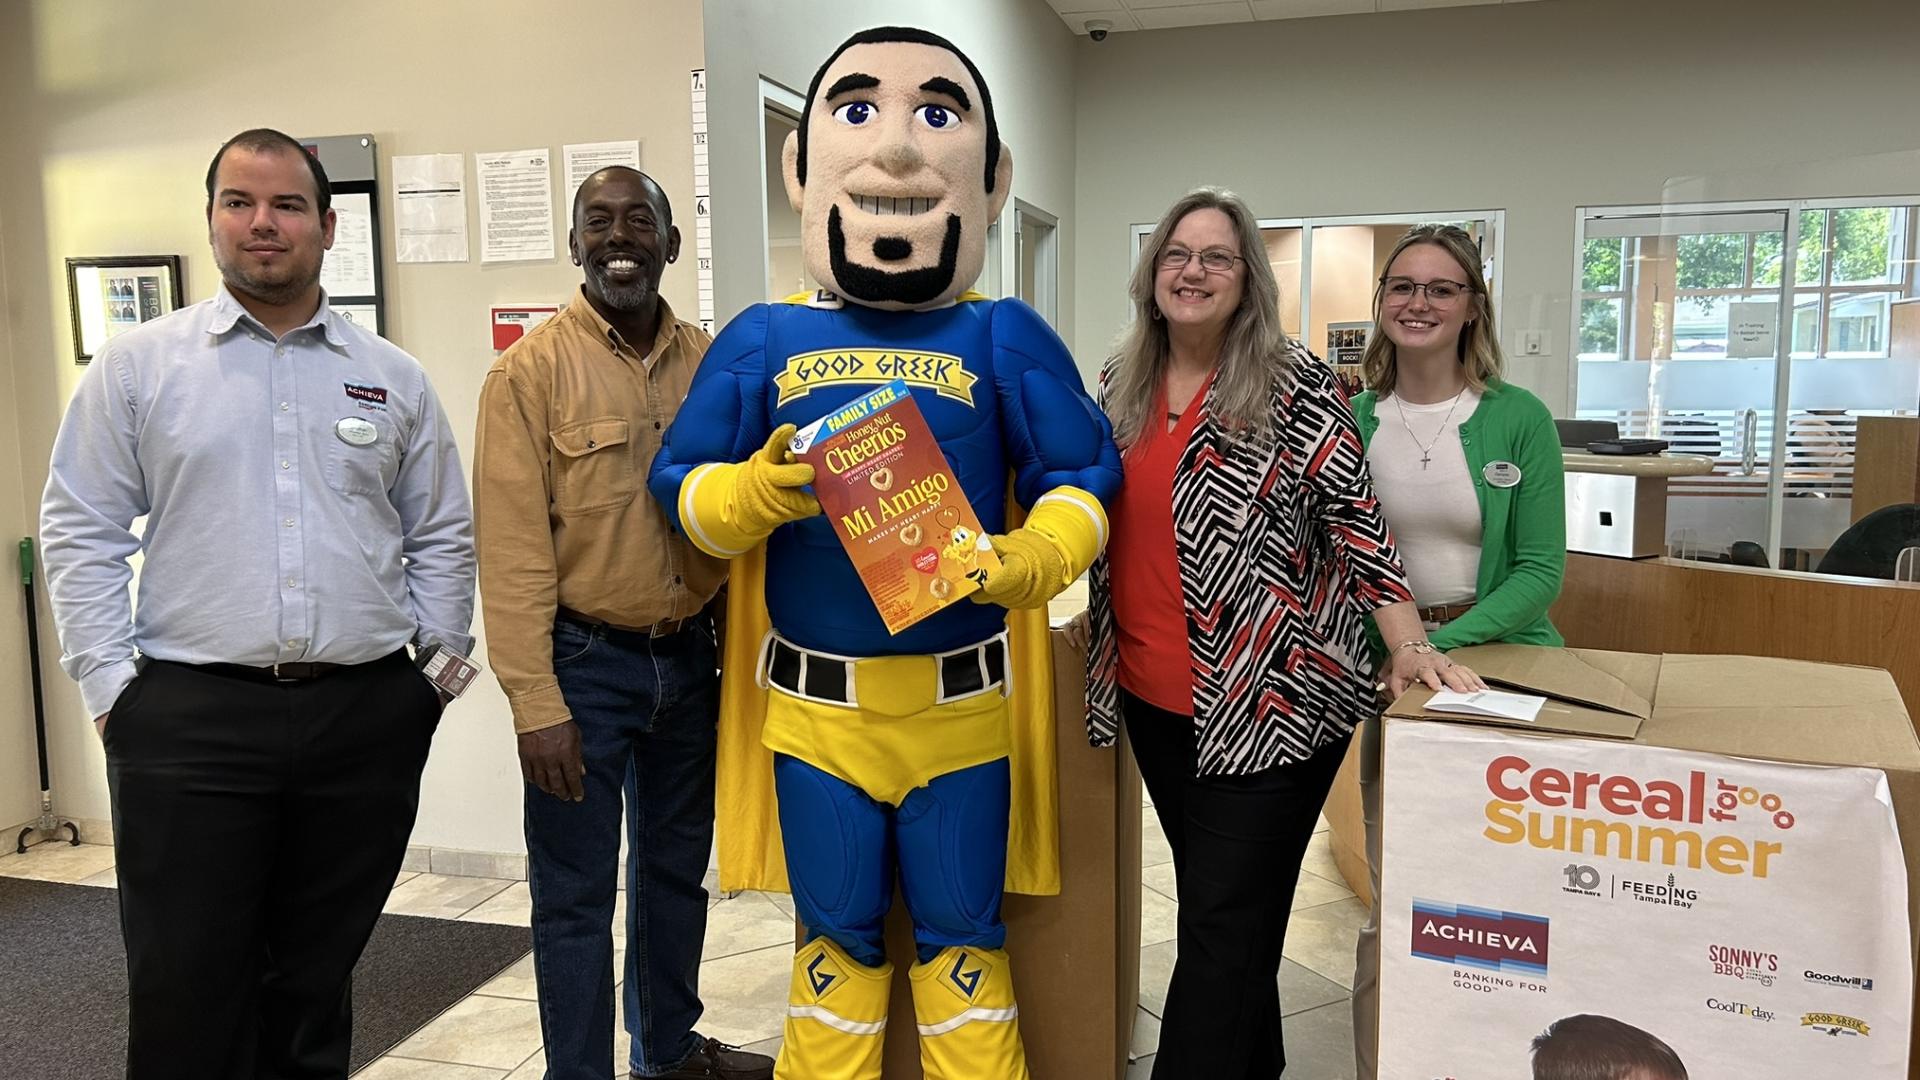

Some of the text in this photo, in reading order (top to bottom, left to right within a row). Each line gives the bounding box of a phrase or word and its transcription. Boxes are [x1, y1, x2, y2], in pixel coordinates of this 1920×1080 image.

[796, 353, 954, 384] GOOD GREEK
[347, 387, 384, 401] ACHIEVA
[826, 387, 897, 433] FAMILY SIZE
[845, 424, 876, 443] Honey
[873, 412, 892, 427] Nut
[825, 422, 907, 475] Cheerios
[847, 467, 875, 485] LIMITED
[875, 452, 904, 470] EDITION
[841, 473, 949, 540] Mi Amigo
[867, 529, 889, 544] MAKES
[900, 513, 920, 526] HEART
[921, 502, 941, 515] HAPPY
[1486, 755, 1738, 824] Cereal for
[1483, 799, 1782, 878] Summer
[1563, 864, 1600, 890] 10
[1622, 879, 1698, 904] FEEDING
[1633, 893, 1692, 909] Tampa Bay
[1421, 919, 1538, 954] ACHIEVA
[1709, 944, 1778, 972] SONNY'S
[1714, 963, 1745, 980] BBQ
[950, 952, 983, 998] G
[1453, 970, 1547, 993] BANKING FOR
[1804, 970, 1861, 985] Goodwill
[1808, 1014, 1833, 1023] GOOD
[1836, 1017, 1864, 1029] GREEK
